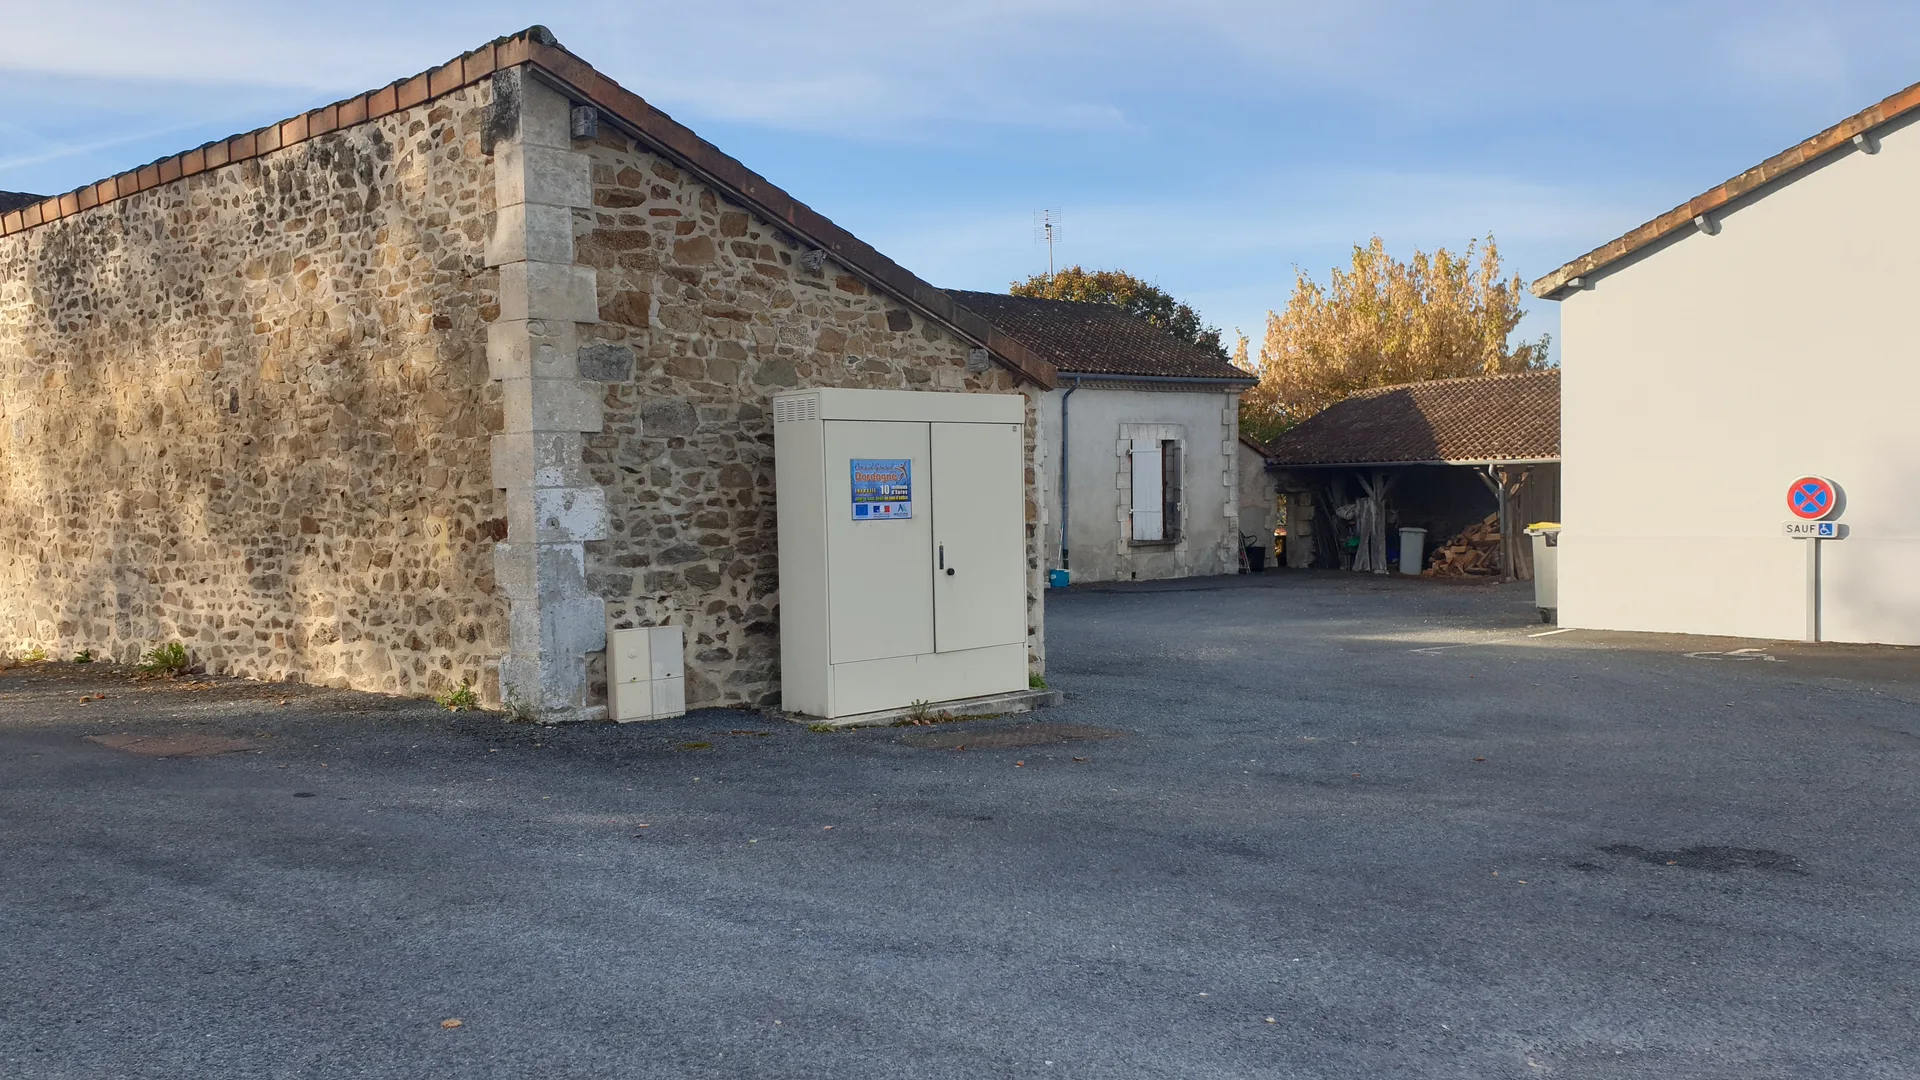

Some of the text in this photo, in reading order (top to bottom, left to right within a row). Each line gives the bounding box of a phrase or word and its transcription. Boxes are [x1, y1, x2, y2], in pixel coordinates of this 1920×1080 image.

[855, 471, 898, 482] Dordogne
[880, 485, 890, 494] 10
[1786, 524, 1816, 532] SAUF
